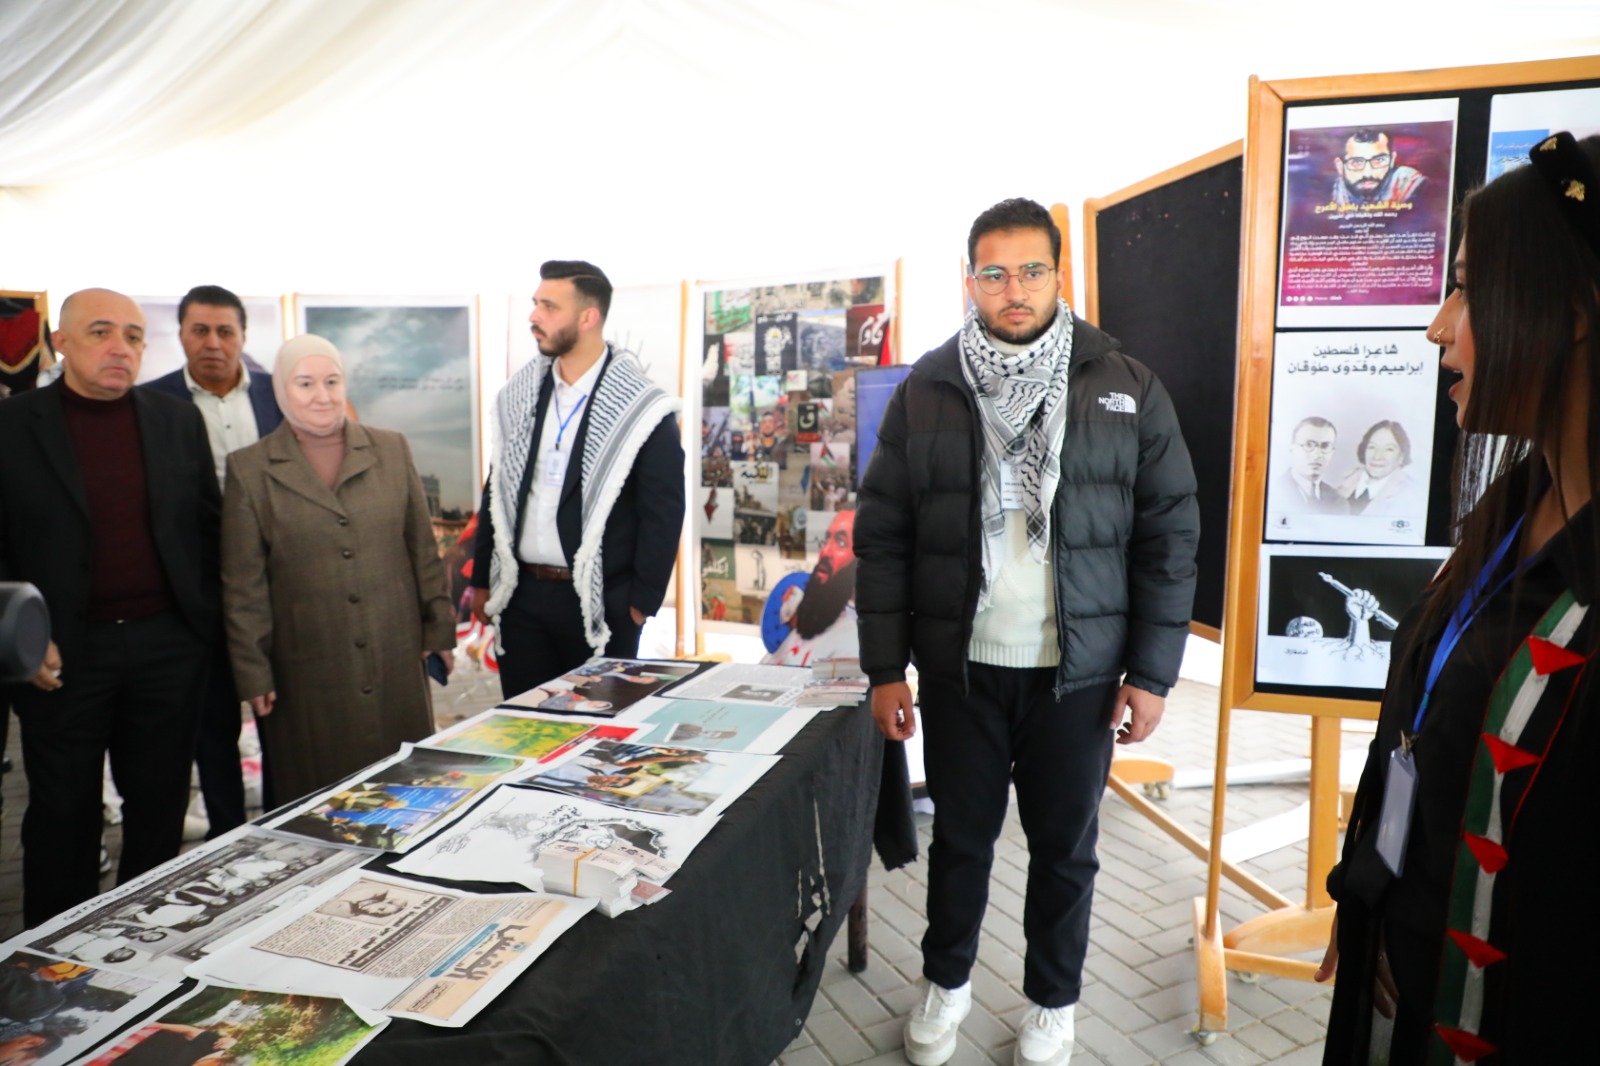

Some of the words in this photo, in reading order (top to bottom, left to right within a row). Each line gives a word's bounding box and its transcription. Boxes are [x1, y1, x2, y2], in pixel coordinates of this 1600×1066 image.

[1360, 201, 1390, 211] الشهيد
[1312, 343, 1360, 358] فلسطين
[1287, 360, 1330, 376] طوقان
[1109, 391, 1125, 399] THE
[1098, 397, 1125, 406] NORTH
[1106, 404, 1125, 412] FACE
